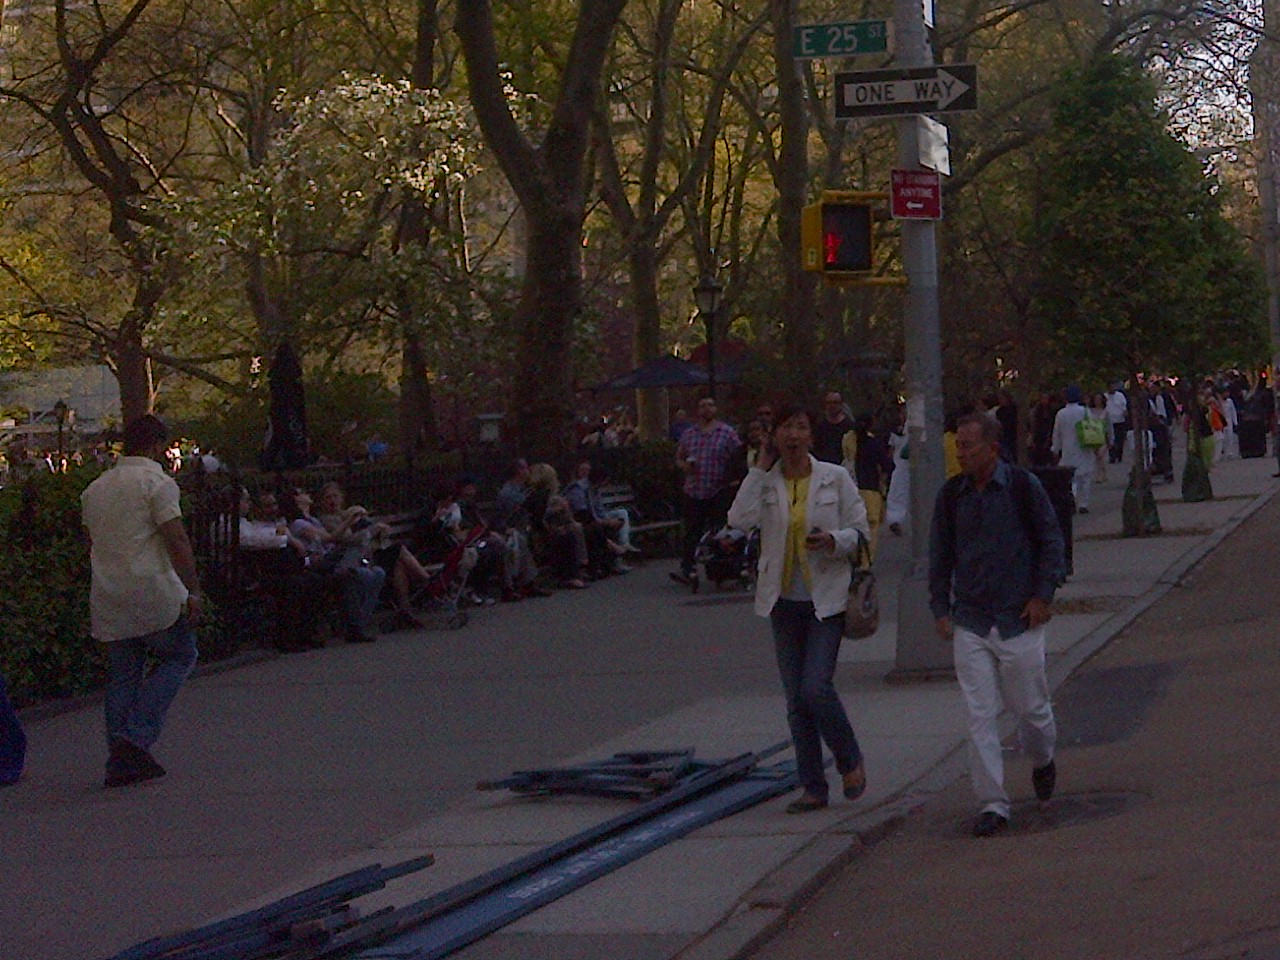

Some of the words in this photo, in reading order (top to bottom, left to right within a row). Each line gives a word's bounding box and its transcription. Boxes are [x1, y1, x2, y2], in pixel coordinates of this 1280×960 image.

[801, 28, 816, 54] E
[827, 26, 858, 53] 25
[868, 24, 883, 39] ST
[855, 83, 895, 103] ONE
[914, 79, 956, 100] WAY
